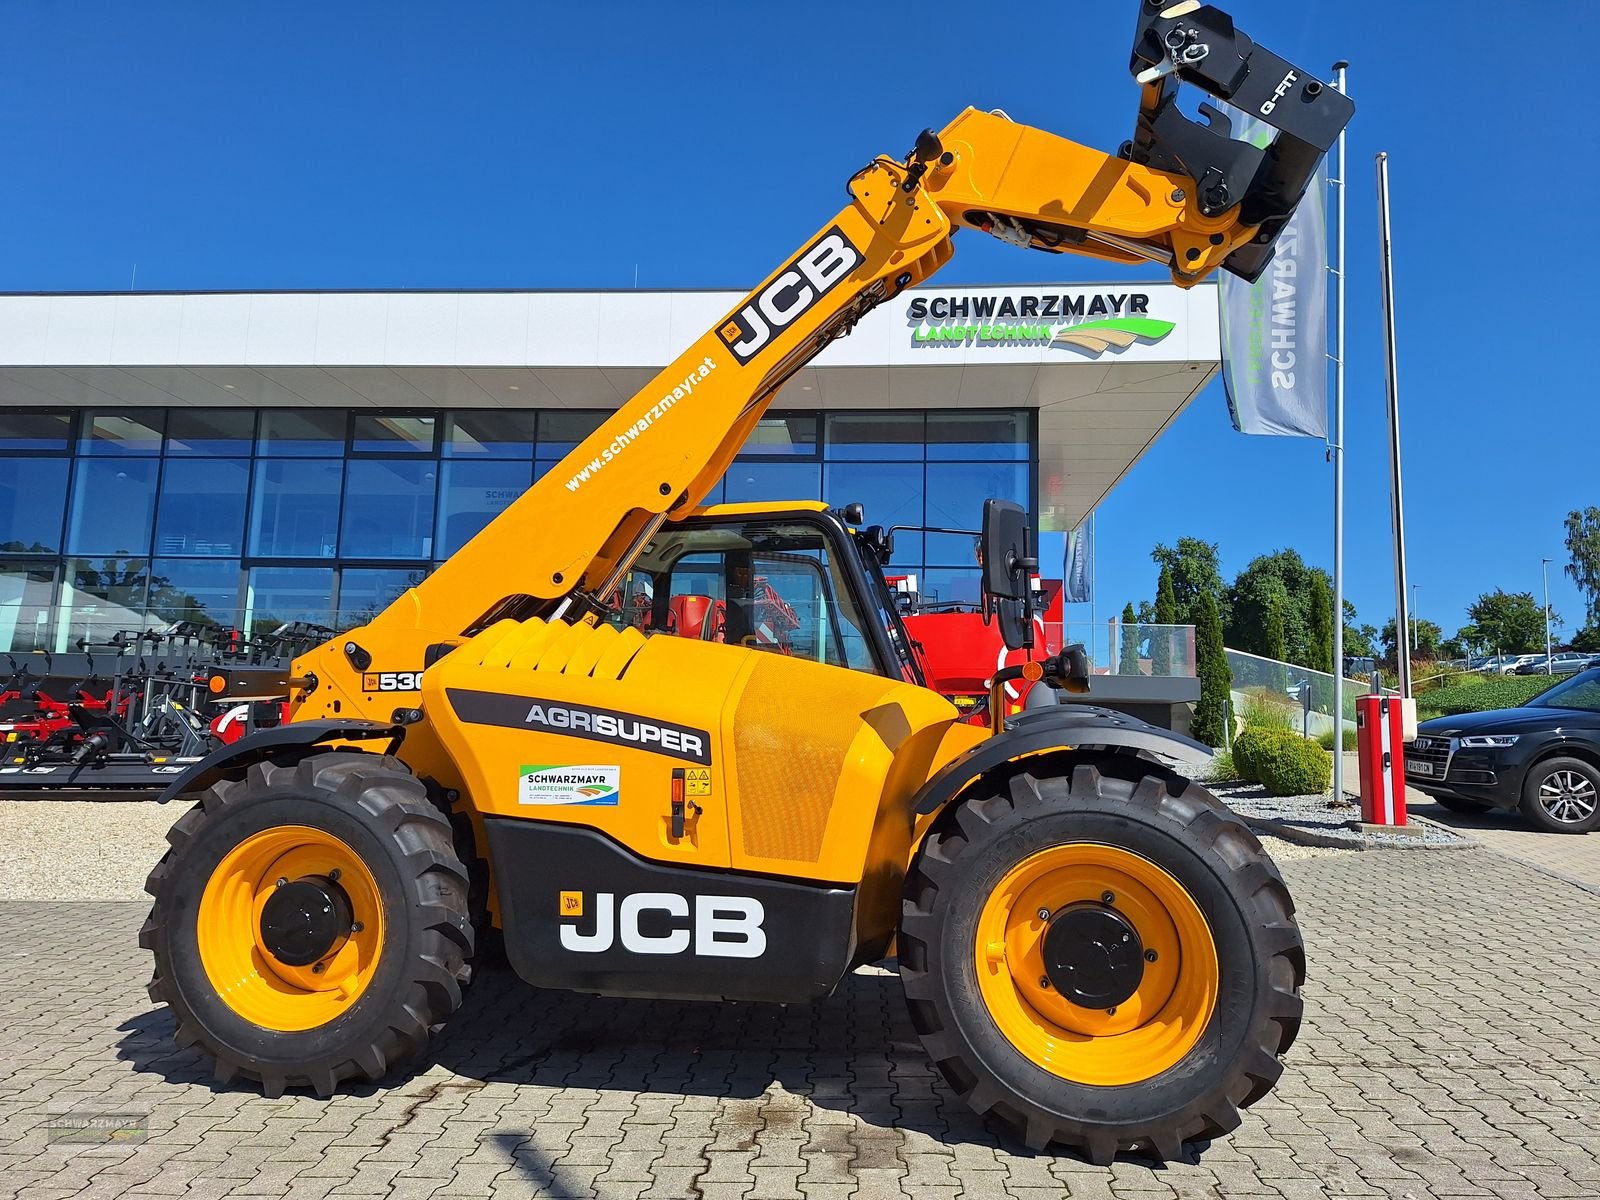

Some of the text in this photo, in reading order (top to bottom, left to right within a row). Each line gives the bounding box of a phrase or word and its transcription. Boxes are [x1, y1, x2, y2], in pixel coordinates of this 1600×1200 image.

[1259, 69, 1298, 116] Q-FIT
[733, 234, 857, 357] JCB
[910, 293, 1149, 319] SCHWARZMAYR
[914, 324, 1051, 342] LANDTECHNIK
[564, 356, 718, 493] www.schwarzmayr.at
[485, 490, 522, 499] SCHWA
[525, 704, 703, 757] AGRISUPER
[527, 774, 606, 784] SCHWARZMAYR
[560, 892, 767, 958] JCB
